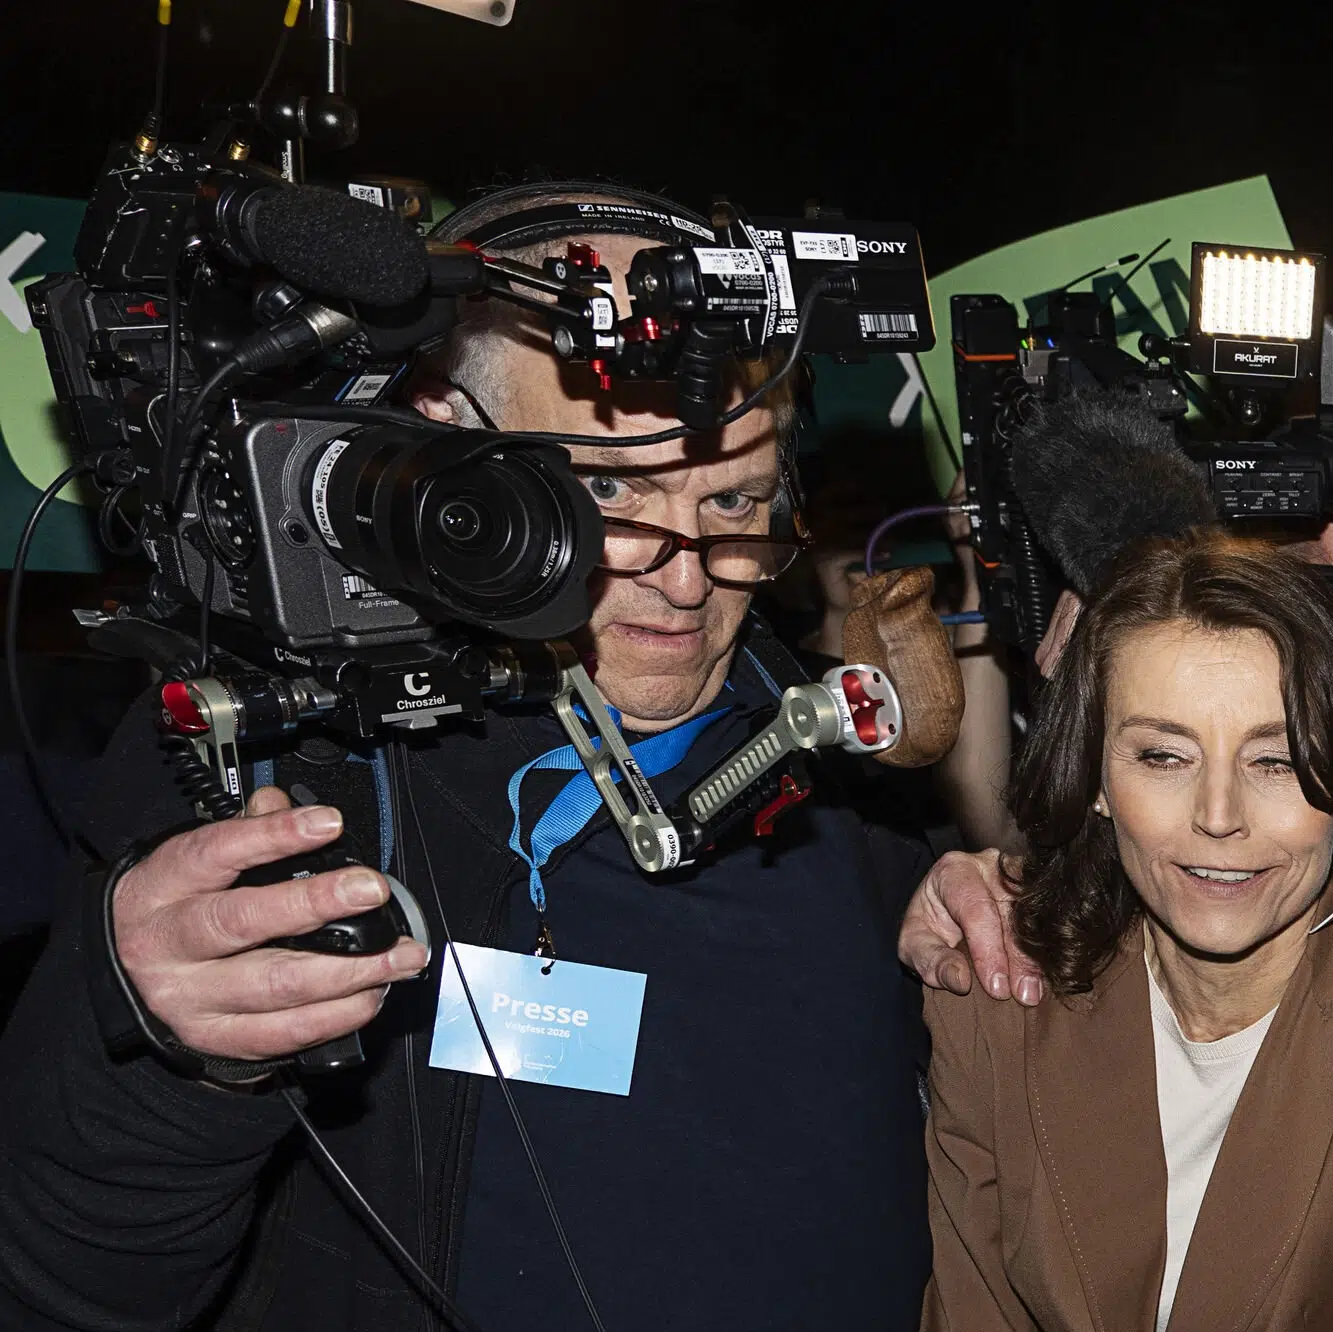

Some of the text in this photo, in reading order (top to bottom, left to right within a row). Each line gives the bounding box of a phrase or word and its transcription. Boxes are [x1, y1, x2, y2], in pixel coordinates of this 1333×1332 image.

[596, 205, 669, 221] SENNHEISER
[857, 240, 907, 253] SONY
[766, 311, 778, 337] VOCAS
[1234, 353, 1277, 364] AKURAT
[1215, 460, 1257, 470] SONY
[358, 599, 400, 609] Full-Frame
[396, 693, 446, 711] Chrosziel
[491, 991, 589, 1027] Presse
